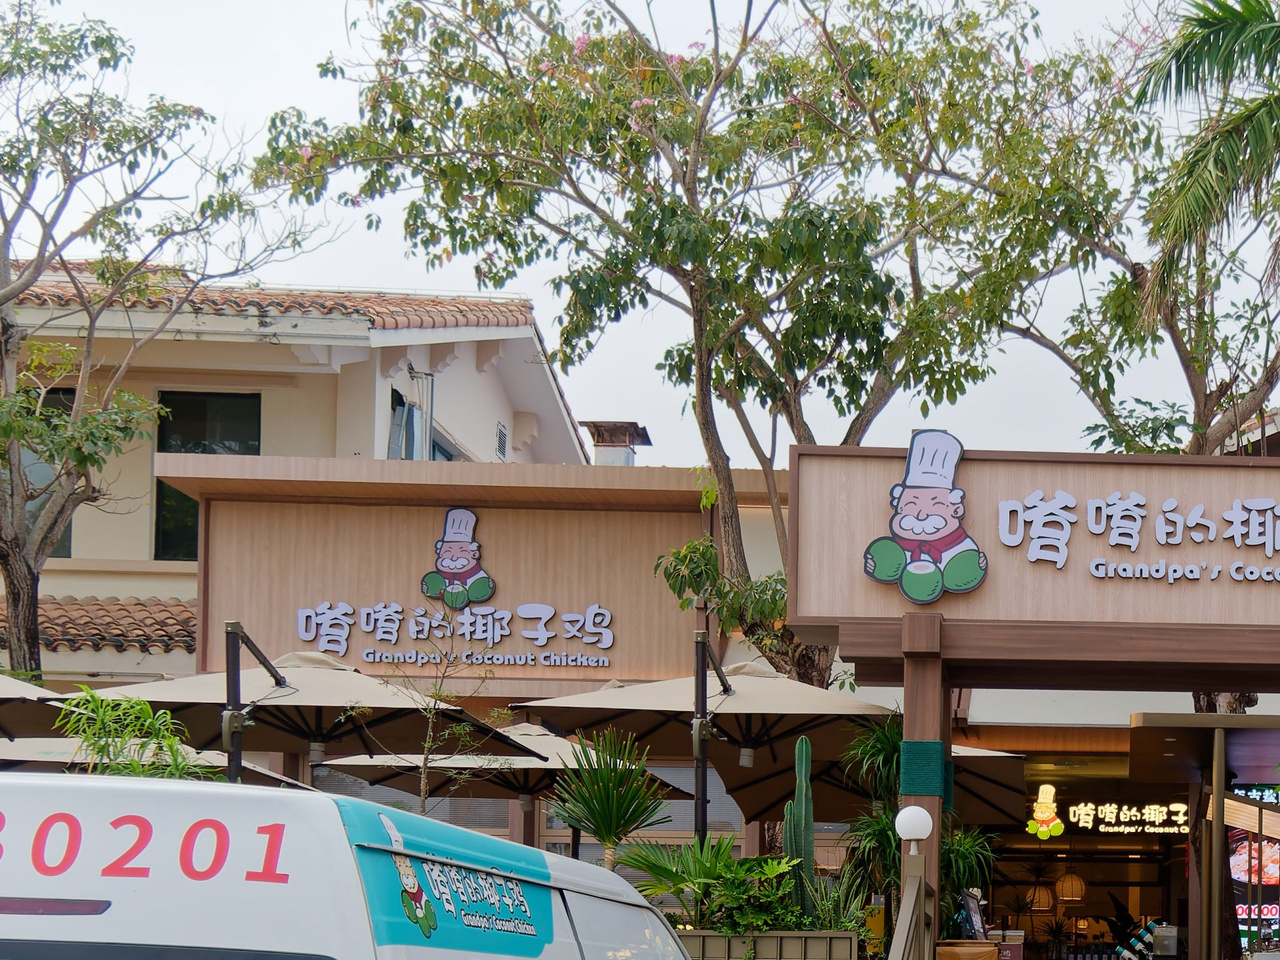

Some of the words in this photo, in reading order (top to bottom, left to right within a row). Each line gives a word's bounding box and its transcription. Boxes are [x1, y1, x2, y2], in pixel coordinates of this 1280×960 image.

[1089, 558, 1222, 585] Grandpa's
[361, 648, 458, 668] Grandpa's
[461, 650, 537, 667] Coconut
[540, 651, 610, 668] Chicken
[1144, 825, 1179, 834] Coconut
[0, 811, 290, 884] 0201
